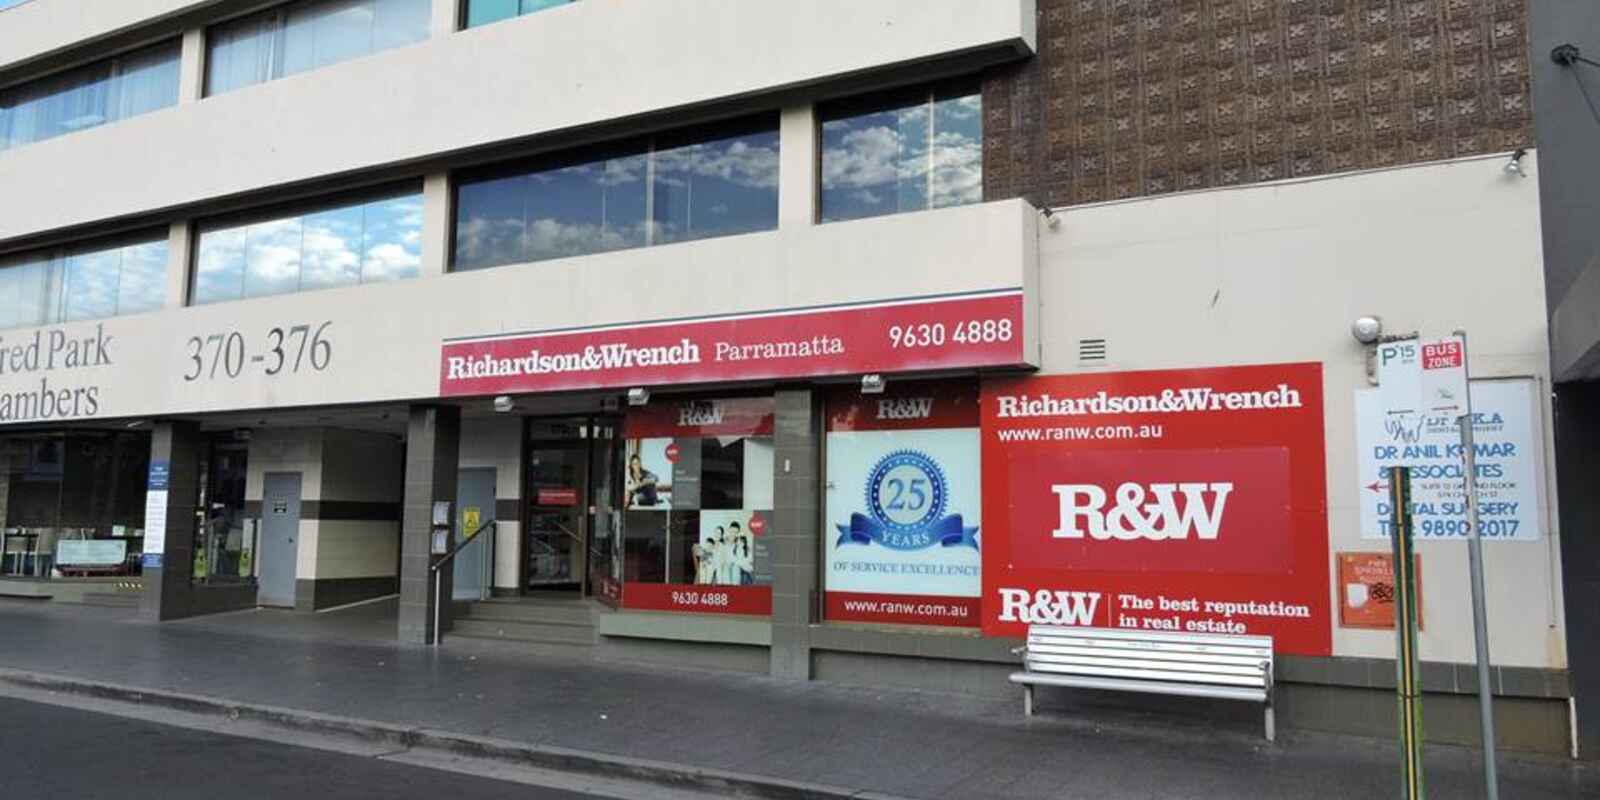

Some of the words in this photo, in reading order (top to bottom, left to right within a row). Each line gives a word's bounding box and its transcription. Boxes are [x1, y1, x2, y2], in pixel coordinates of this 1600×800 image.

[0, 331, 40, 374] red
[46, 323, 114, 371] Park
[184, 320, 332, 381] 370-376
[447, 338, 700, 379] Richardson&Wrench
[715, 334, 845, 361] Parramatta
[889, 323, 945, 348] 9630
[952, 318, 1013, 343] 4888
[1425, 344, 1457, 357] BUS
[1428, 356, 1457, 369] ZONE
[0, 377, 98, 421] ambers
[876, 398, 934, 420] R&W
[997, 384, 1302, 418] Richardson&Wrench
[998, 424, 1163, 442] www.ranw.com.au
[1374, 445, 1398, 459] DR
[1402, 444, 1441, 459] ANIL
[1409, 463, 1503, 479] SSOCITES
[886, 477, 926, 511] 25
[1051, 481, 1233, 541] R&W
[1377, 502, 1438, 516] DTAL
[1441, 501, 1519, 516] SUGERY
[1421, 519, 1471, 537] 9890
[1478, 518, 1520, 537] 2017
[880, 531, 930, 547] YEARS
[833, 561, 848, 572] OF
[851, 561, 899, 574] SERVICE
[671, 591, 699, 605] 9630
[700, 592, 728, 606] 4888
[844, 599, 968, 617] www.ranw.com.au
[998, 588, 1101, 626] R&W
[1119, 594, 1154, 611] The
[1159, 595, 1200, 613] best
[1204, 597, 1311, 619] reputation
[1119, 612, 1139, 629] in
[1143, 613, 1182, 631] real
[1186, 617, 1247, 635] estate
